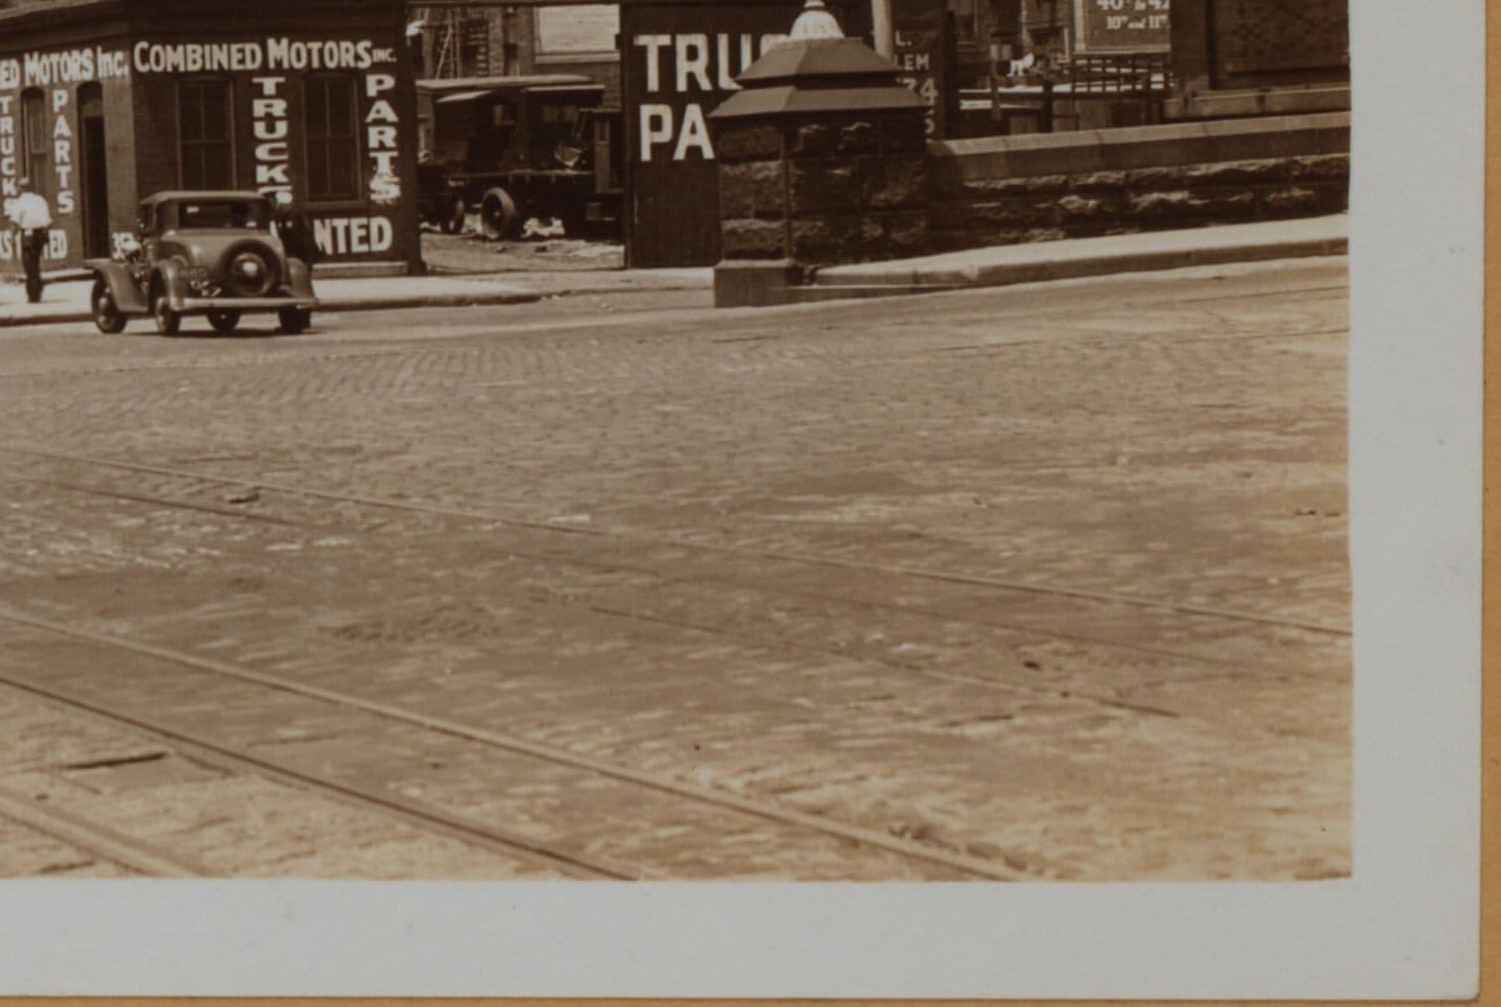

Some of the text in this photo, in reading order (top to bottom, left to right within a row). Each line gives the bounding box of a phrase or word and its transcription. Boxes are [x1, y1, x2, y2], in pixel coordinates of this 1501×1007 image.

[23, 47, 94, 87] MOTORS
[96, 45, 129, 80] Inc.
[134, 37, 398, 72] COMBINED MOTORS INC.
[52, 89, 75, 215] PARTS
[364, 74, 400, 204] PARTS
